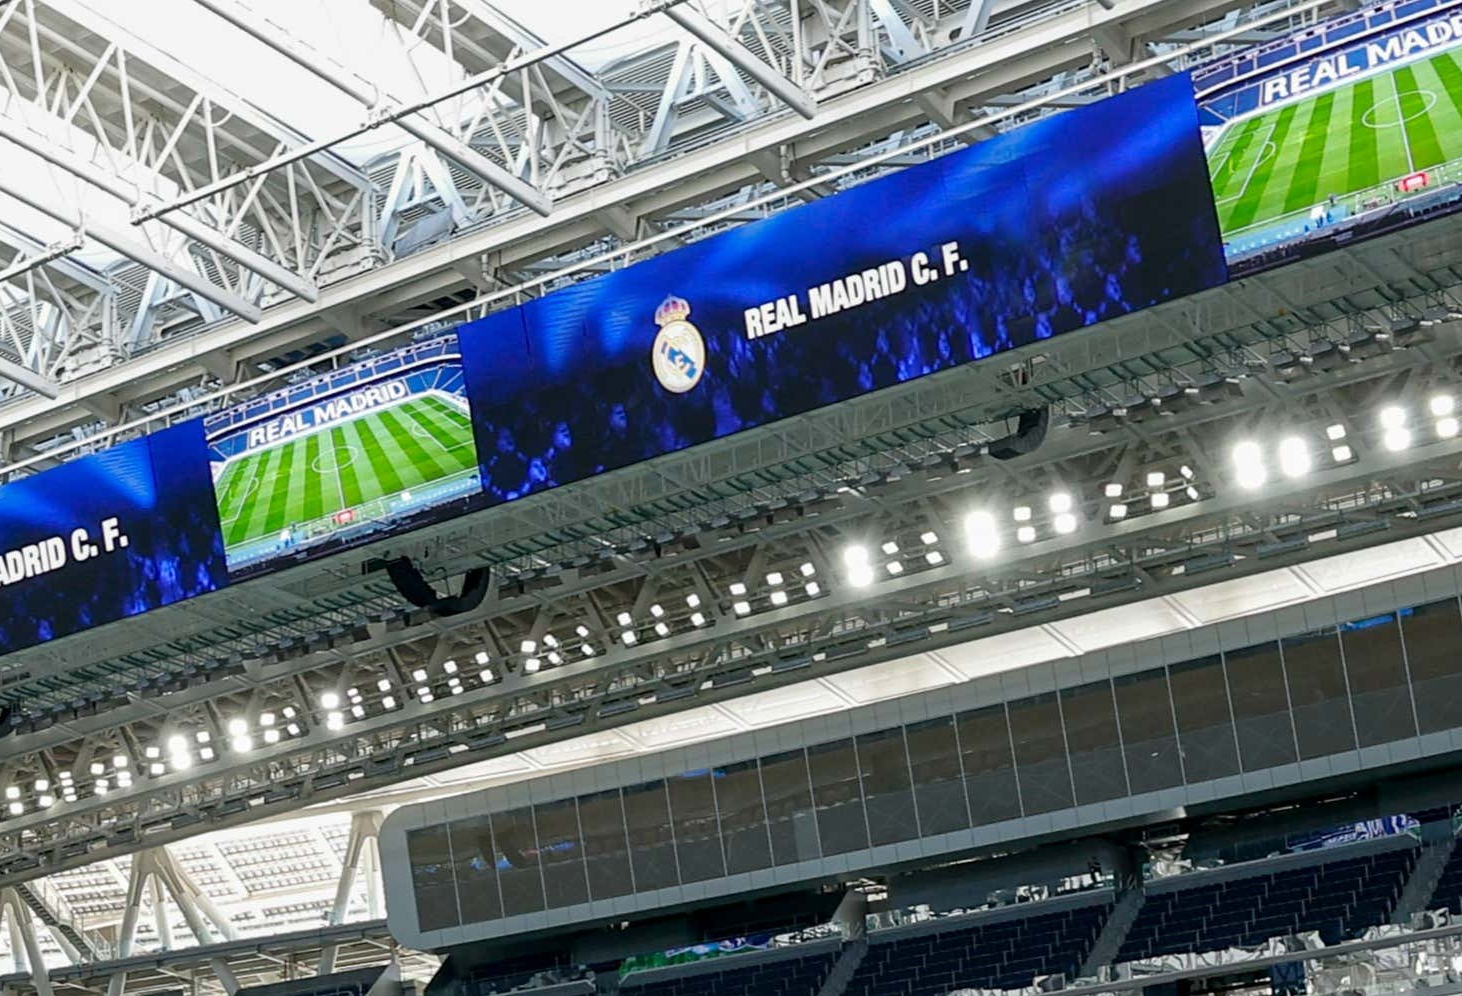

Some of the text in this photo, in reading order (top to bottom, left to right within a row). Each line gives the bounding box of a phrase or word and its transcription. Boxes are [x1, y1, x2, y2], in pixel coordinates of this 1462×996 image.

[1263, 54, 1358, 104] REAL
[744, 242, 969, 340] REAL MADRID C. F.
[248, 379, 406, 447] REAL MADRID
[71, 527, 98, 563] C.
[103, 518, 129, 552] F.
